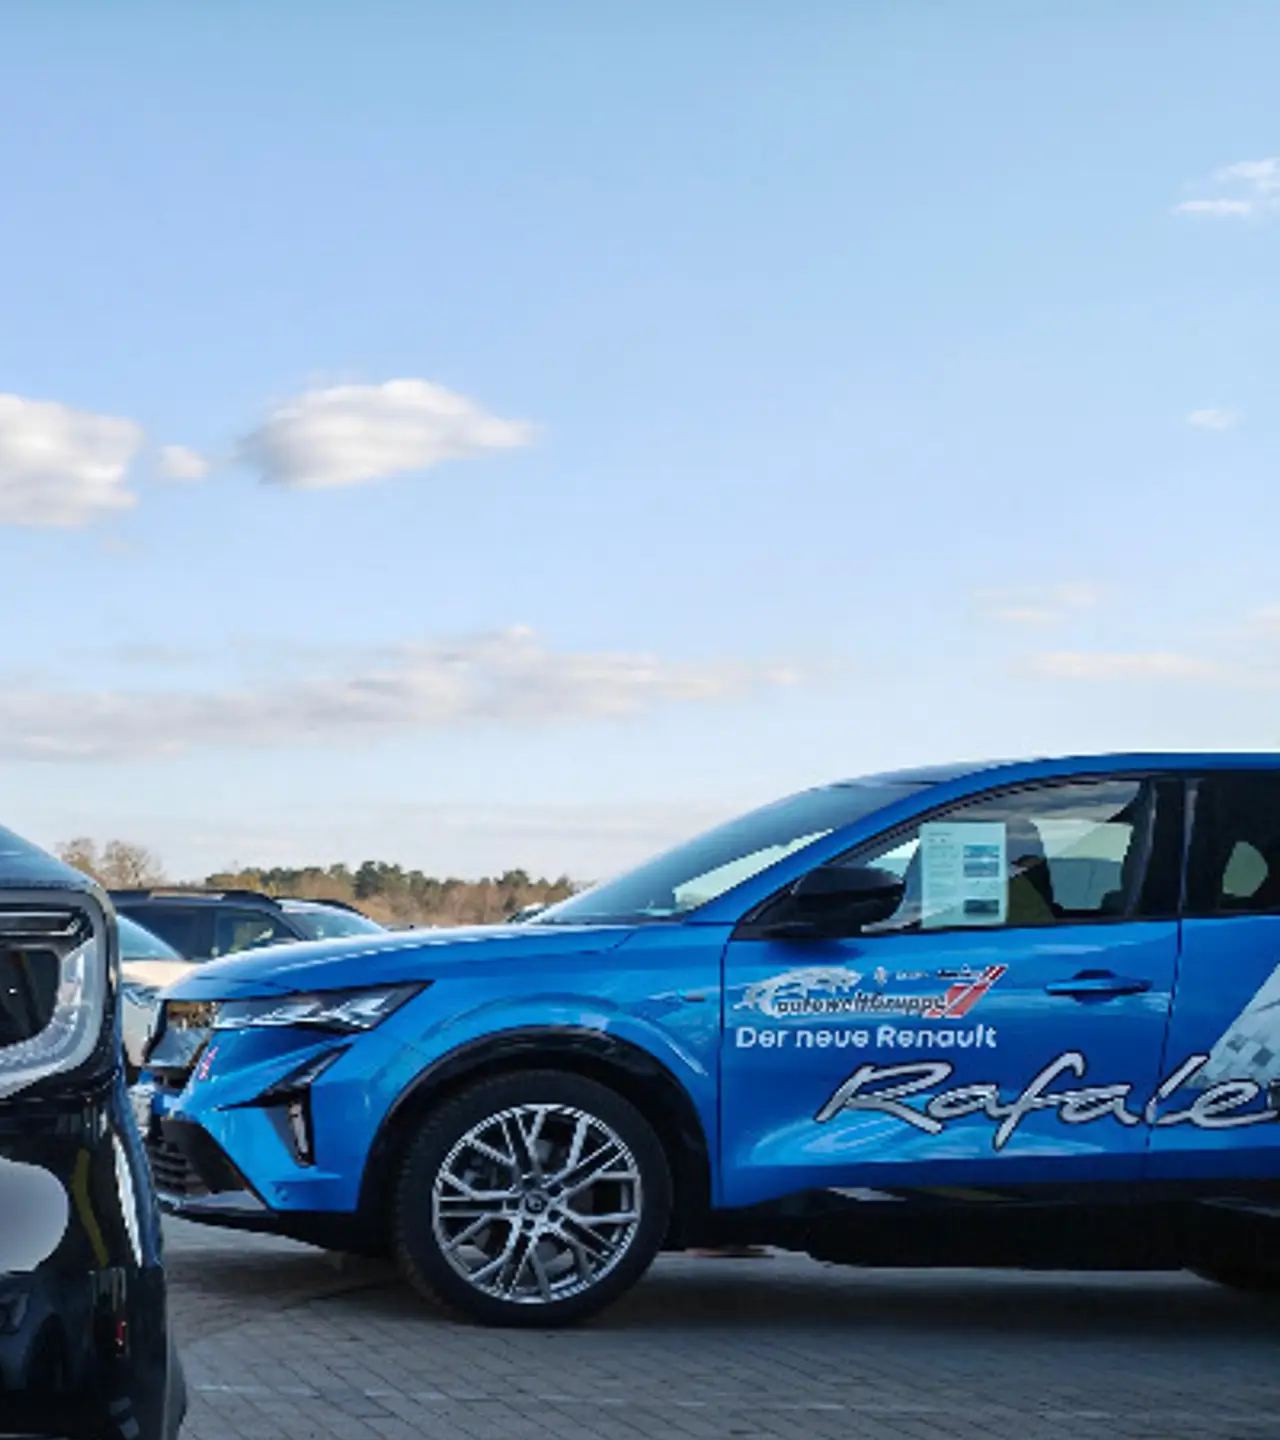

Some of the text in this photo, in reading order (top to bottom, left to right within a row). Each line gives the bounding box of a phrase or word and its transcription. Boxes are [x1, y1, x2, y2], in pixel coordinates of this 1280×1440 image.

[735, 1023, 998, 1049] Der neue Renault
[812, 1050, 1278, 1153] Rafale
